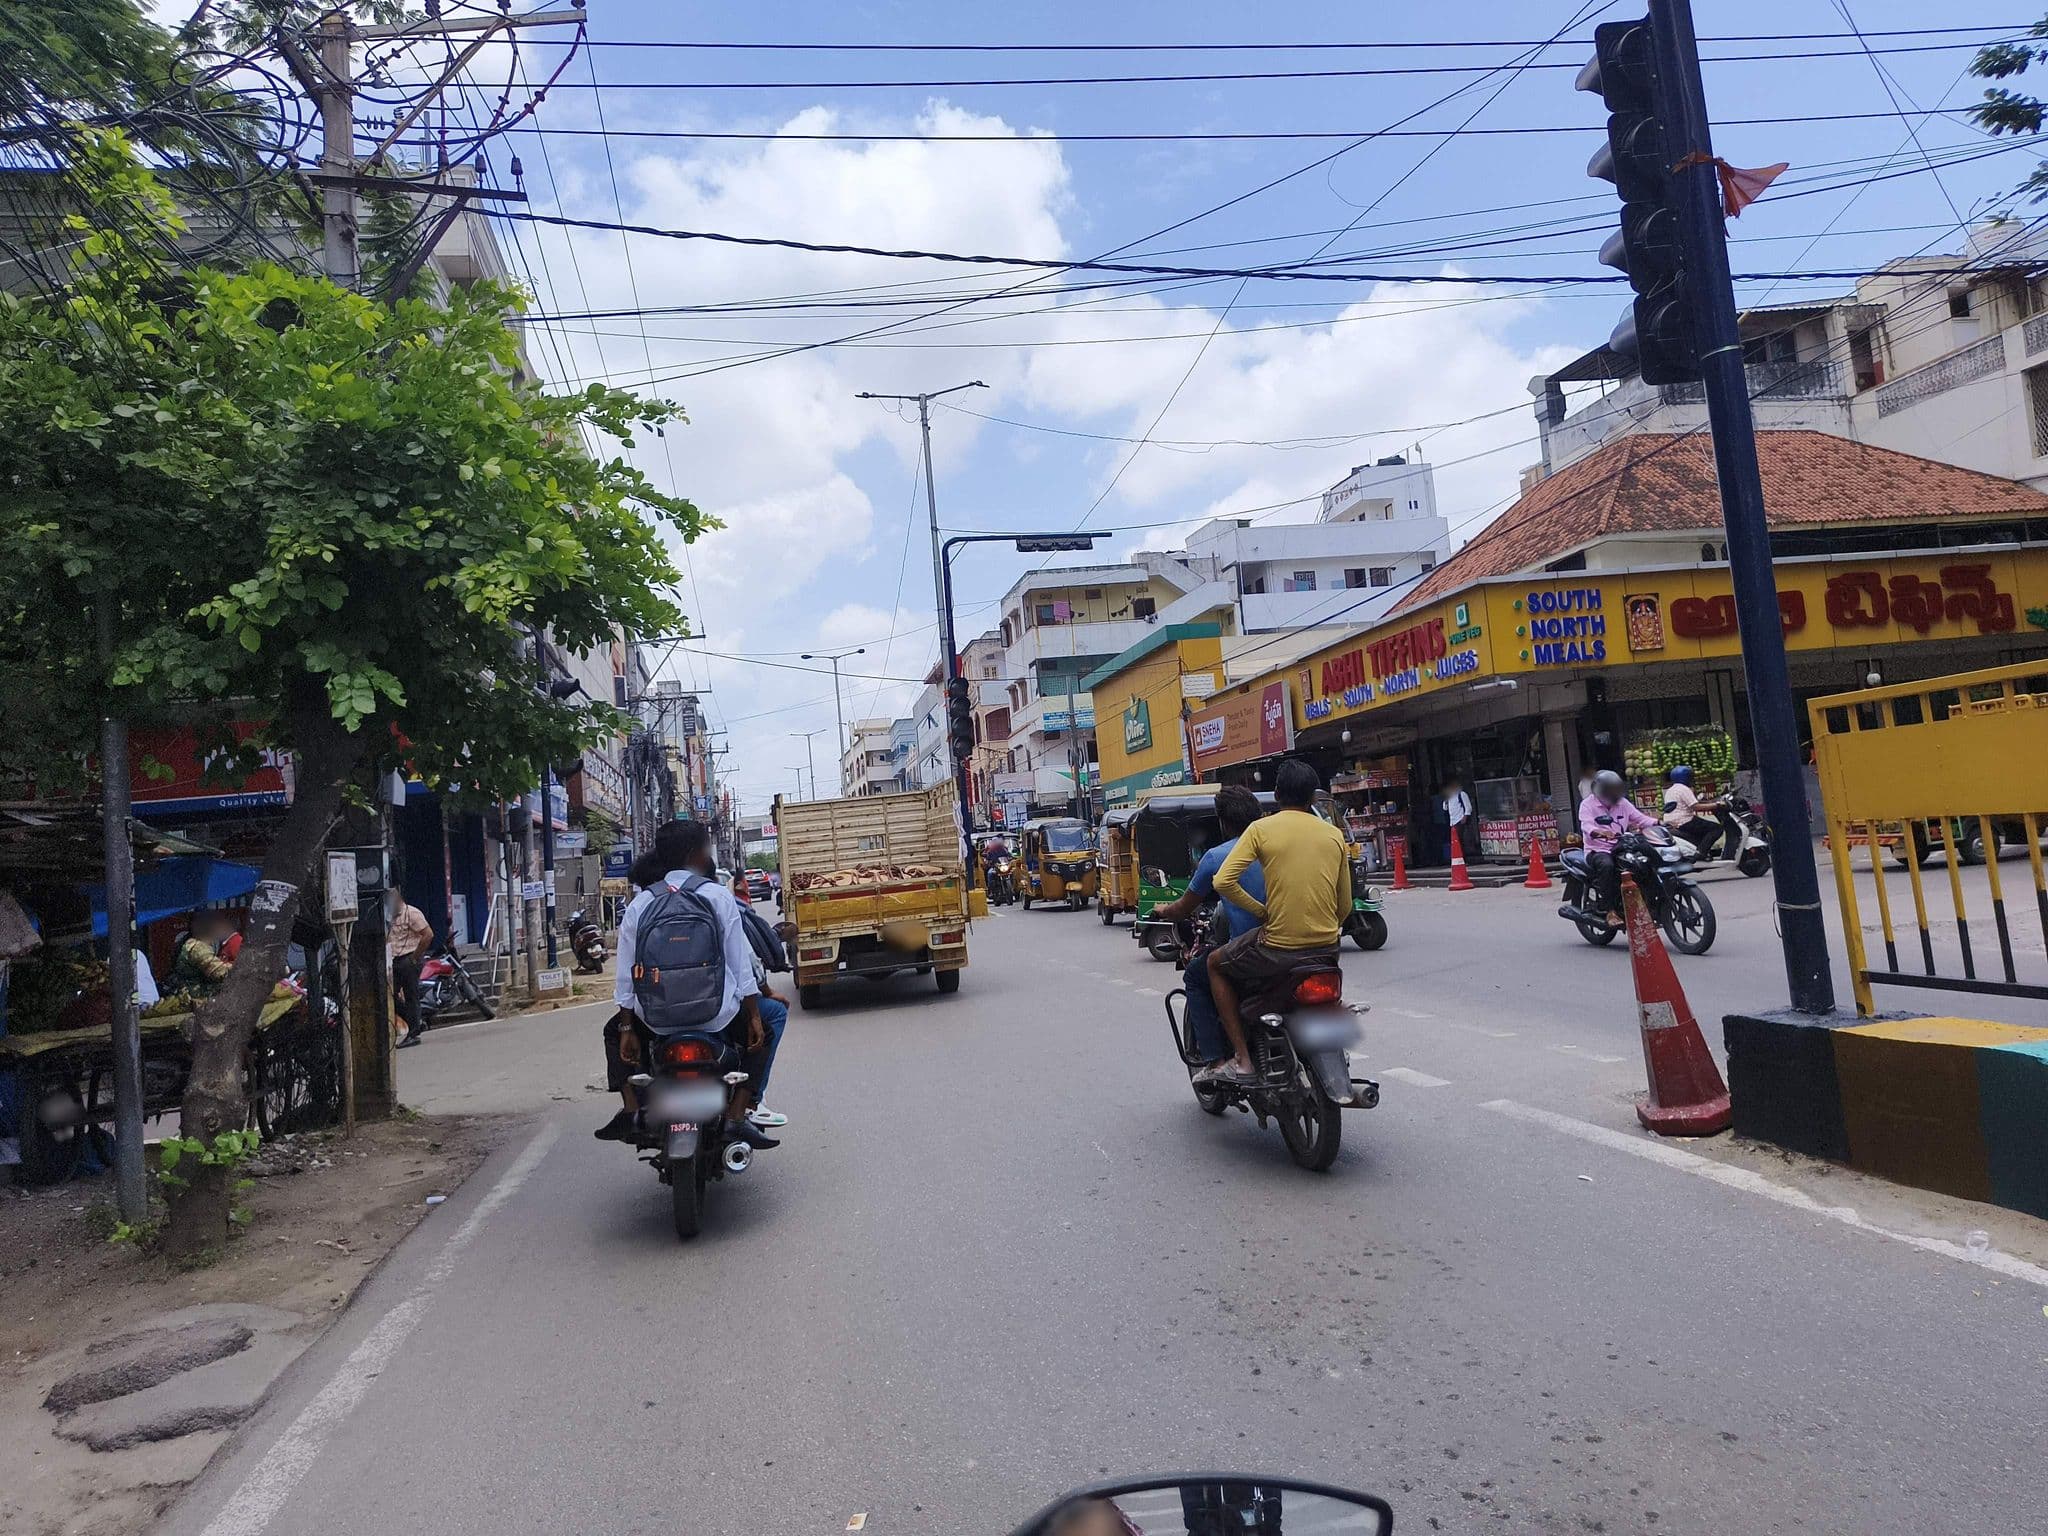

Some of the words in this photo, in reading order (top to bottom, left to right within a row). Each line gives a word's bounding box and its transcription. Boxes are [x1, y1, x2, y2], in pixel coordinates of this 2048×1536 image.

[1527, 588, 1602, 614] SOUTH
[1530, 614, 1606, 641] NORTH
[1322, 649, 1366, 695] ABHI
[1367, 618, 1447, 680] TIFFINS
[1534, 639, 1607, 665] MEALS
[1304, 698, 1332, 720] MEALS
[1344, 683, 1375, 708] SOUTH
[1384, 667, 1421, 695] NORTH
[1435, 649, 1479, 680] JUICES
[1202, 722, 1221, 737] SNEHA
[219, 796, 258, 807] Quality
[1500, 830, 1517, 839] POINT
[1540, 820, 1557, 828] POINT
